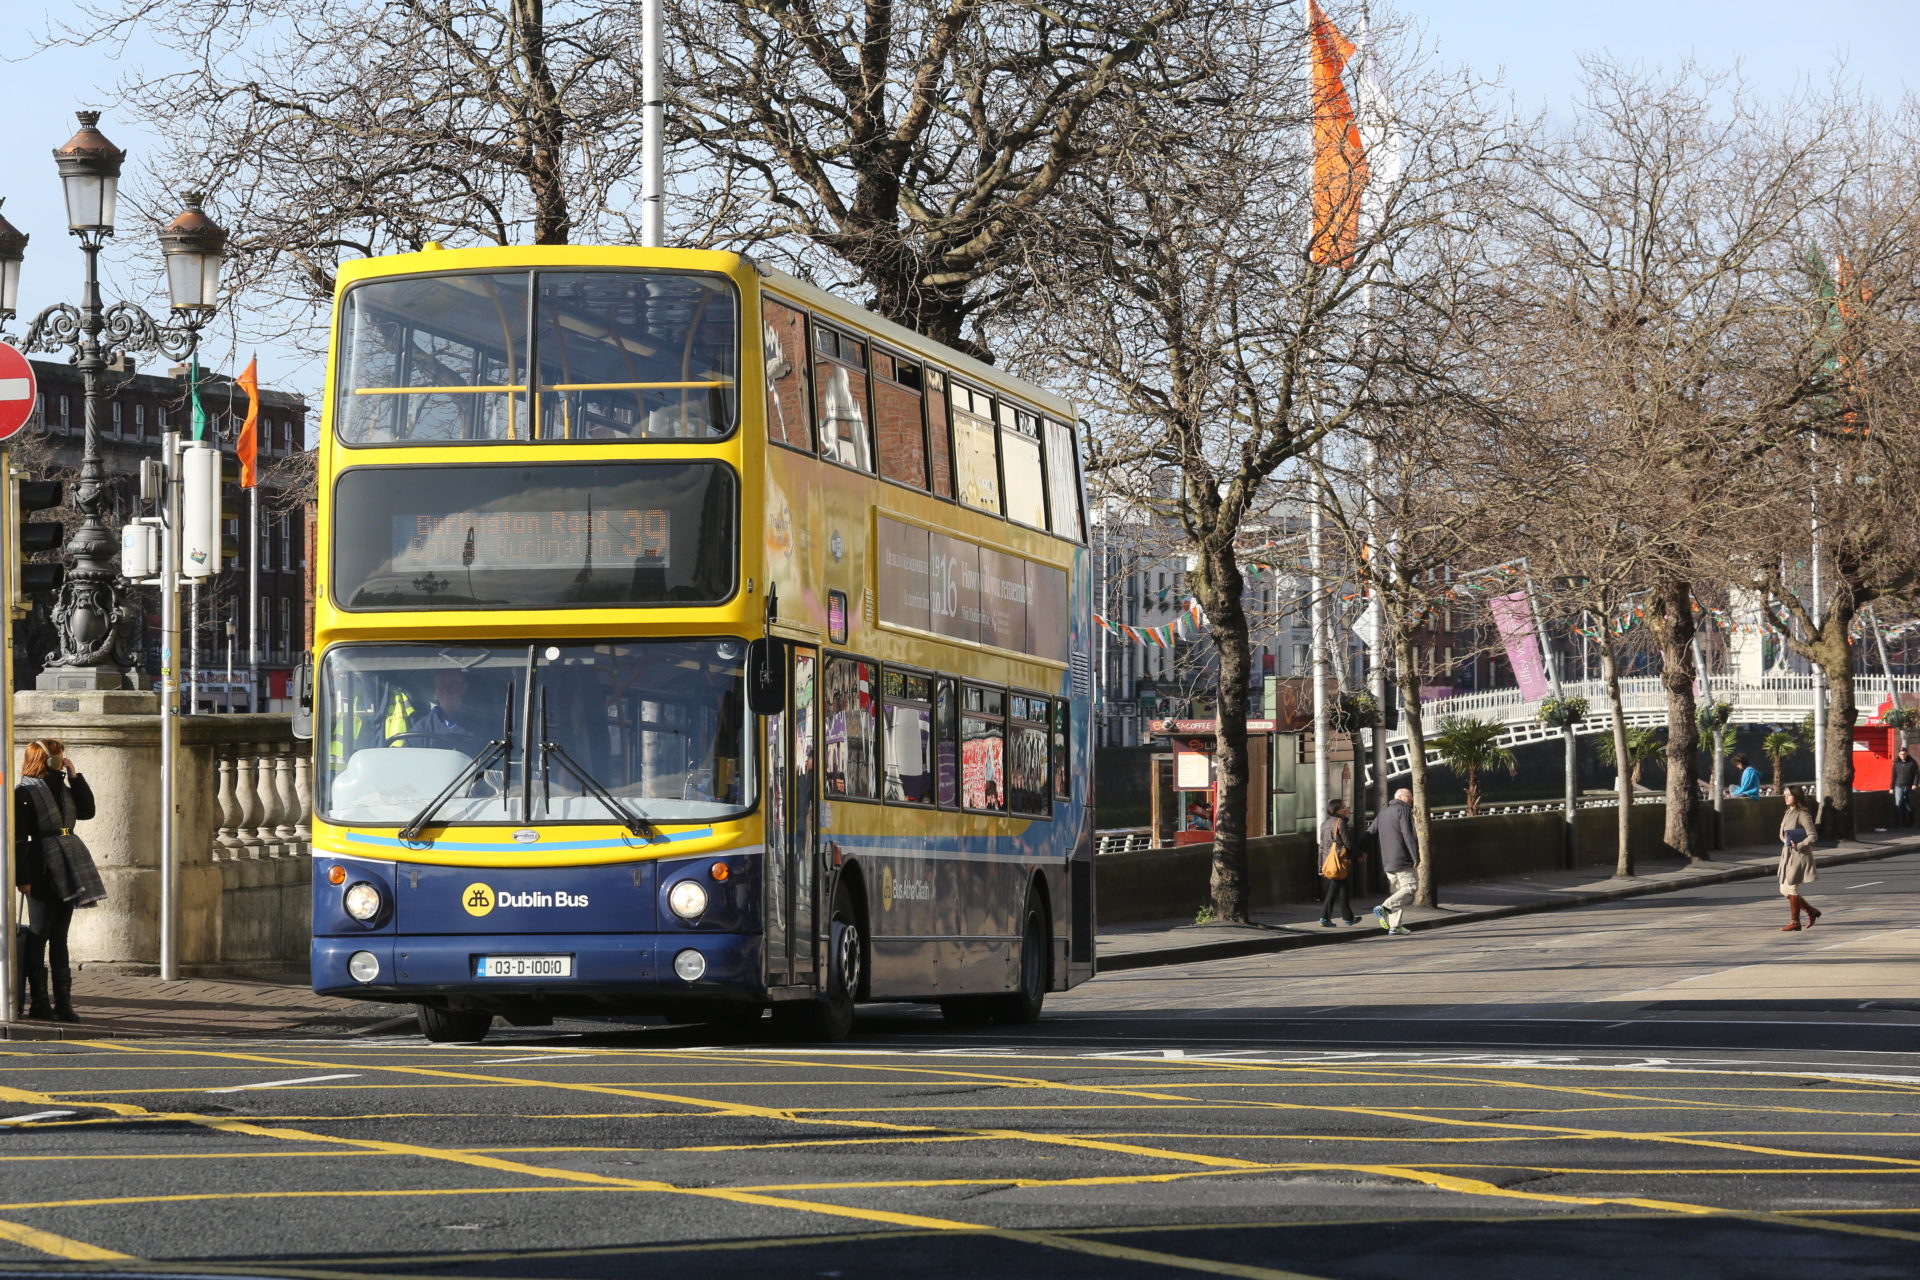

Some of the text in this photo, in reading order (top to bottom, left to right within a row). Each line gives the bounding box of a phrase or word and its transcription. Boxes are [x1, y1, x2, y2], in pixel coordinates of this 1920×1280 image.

[417, 510, 609, 536] Burlington Road
[623, 509, 667, 556] 39
[931, 555, 940, 577] 19
[939, 553, 958, 618] 16
[961, 560, 977, 591] How
[1000, 576, 1033, 606] remembr?
[498, 891, 589, 907] Dublin Bus
[893, 879, 903, 899] Bus
[496, 960, 562, 975] 03-D-10010
